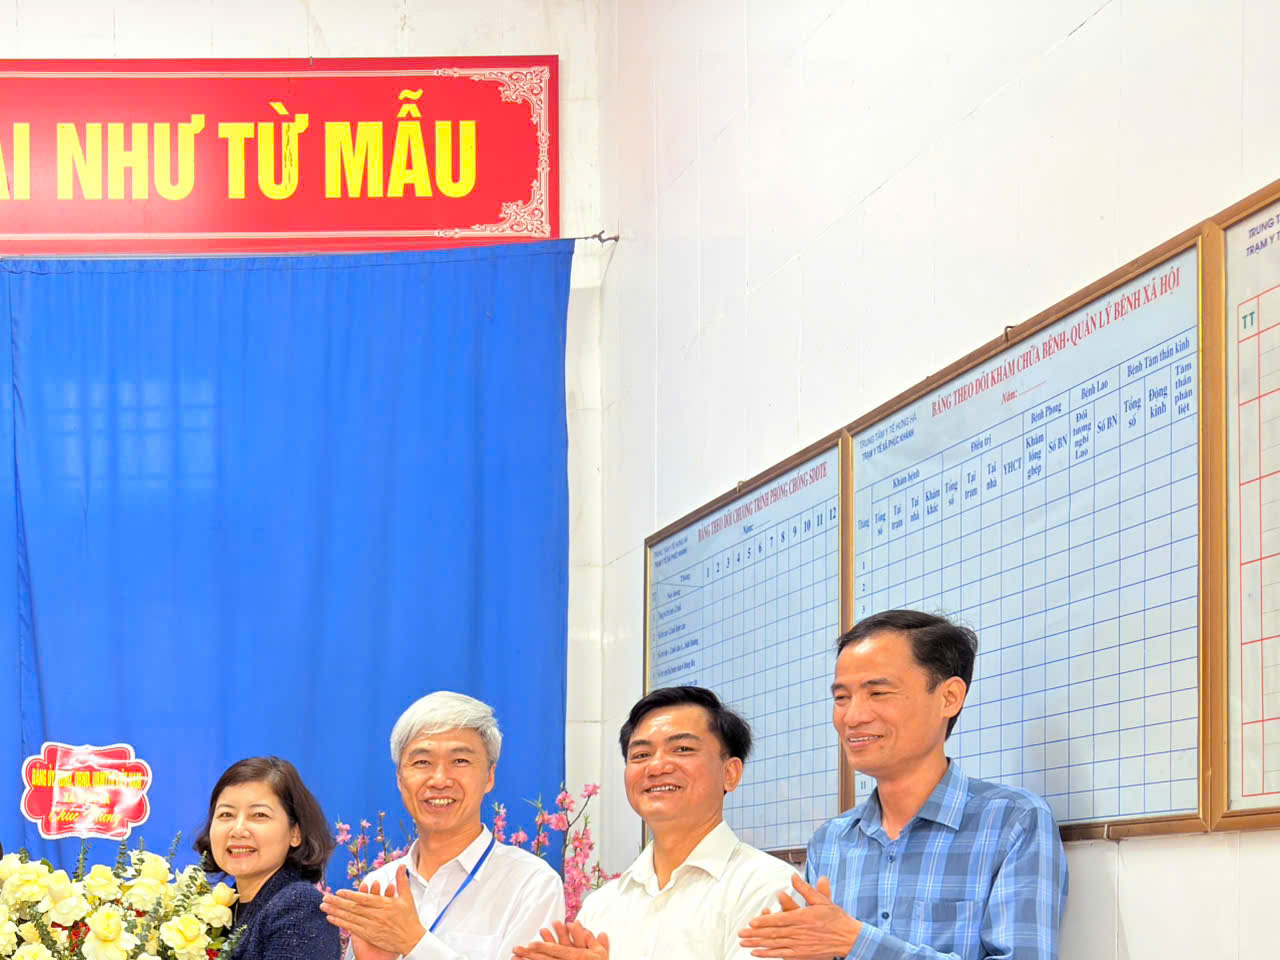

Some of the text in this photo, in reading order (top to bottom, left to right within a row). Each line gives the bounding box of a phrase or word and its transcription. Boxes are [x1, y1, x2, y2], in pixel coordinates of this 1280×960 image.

[57, 114, 205, 200] NHƯ
[219, 102, 309, 199] TỪ
[325, 89, 476, 197] MẪU
[1248, 217, 1275, 239] TRUNG
[1245, 237, 1269, 257] TRẠM
[1242, 311, 1255, 330] TT
[931, 393, 952, 418] BẢNG
[953, 381, 974, 407] THEO
[975, 371, 990, 395] DÕI
[991, 358, 1016, 389] KHÁM
[1017, 344, 1041, 373] CHỮA
[1099, 301, 1112, 329] LÝ
[1114, 288, 1141, 321] BỆNH
[1143, 276, 1158, 305] XÃ
[1160, 265, 1181, 295] HỘI
[1127, 337, 1190, 377] Bệnh Tâm thần kinh
[1175, 362, 1192, 376] Tâm
[1081, 379, 1109, 400] Bệnh Lao
[1175, 375, 1192, 390] thần
[1149, 385, 1168, 402] Động
[1174, 389, 1193, 406] phân
[1123, 396, 1142, 413] Tổng
[1150, 401, 1167, 419] kinh
[1178, 402, 1190, 416] liệt
[1076, 409, 1088, 423] Đối
[1107, 414, 1118, 430] BN
[1075, 448, 1089, 460] Lao
[1003, 457, 1022, 476] YHCT
[804, 519, 811, 533] 10
[817, 513, 823, 527] 11
[829, 506, 837, 520] 12
